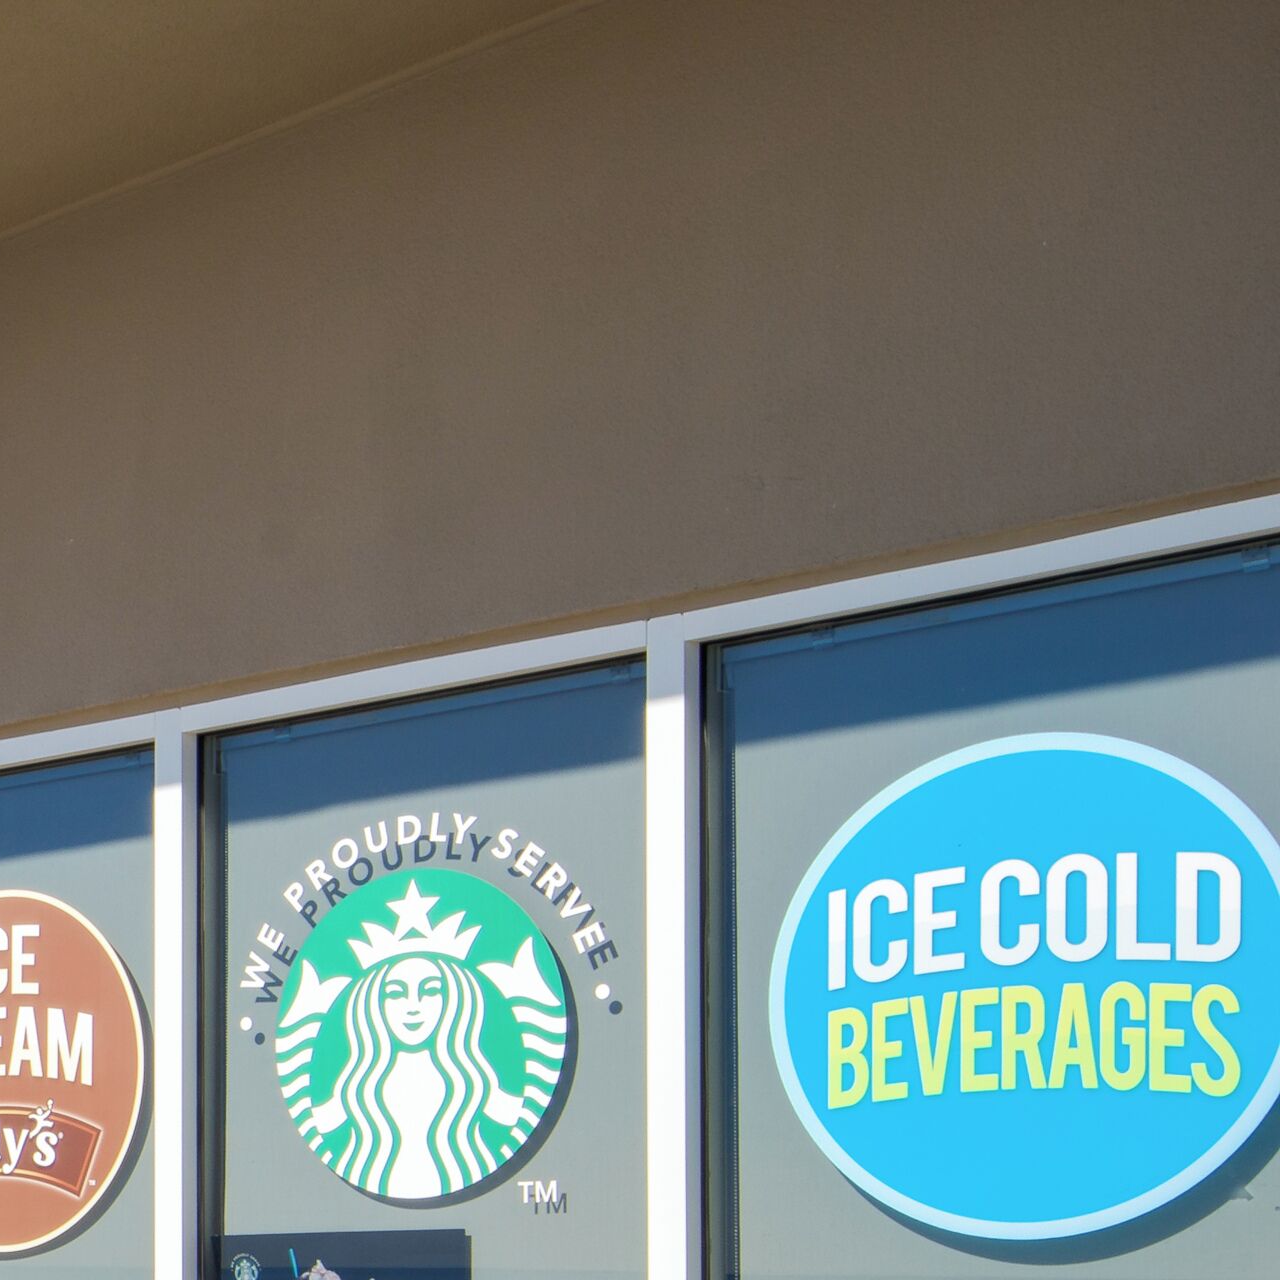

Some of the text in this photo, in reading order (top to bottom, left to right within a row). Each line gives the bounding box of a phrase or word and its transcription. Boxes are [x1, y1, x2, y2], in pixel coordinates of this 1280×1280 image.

[239, 811, 606, 989] WE PROUDLY SERVE
[827, 850, 1242, 992] ICE COLD
[827, 980, 1241, 1110] BEVERAGES
